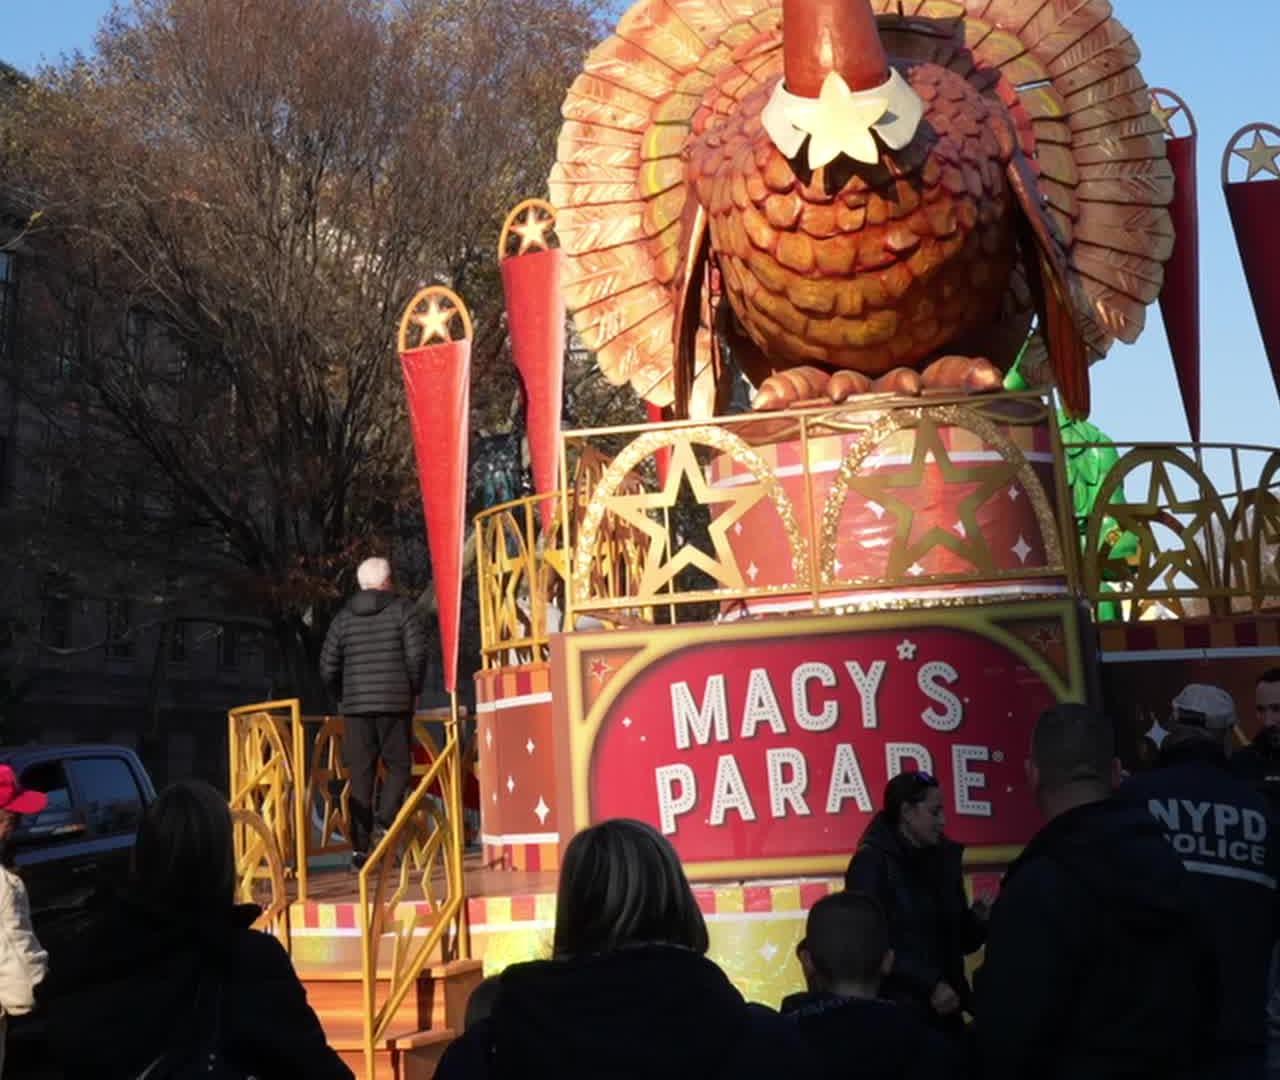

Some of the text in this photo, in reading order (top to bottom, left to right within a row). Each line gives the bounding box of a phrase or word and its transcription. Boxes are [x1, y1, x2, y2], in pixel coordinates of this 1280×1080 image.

[669, 639, 964, 751] MACY'S
[654, 742, 993, 835] PARADE
[1147, 797, 1268, 843] NYPD
[1162, 832, 1268, 865] OLICE
